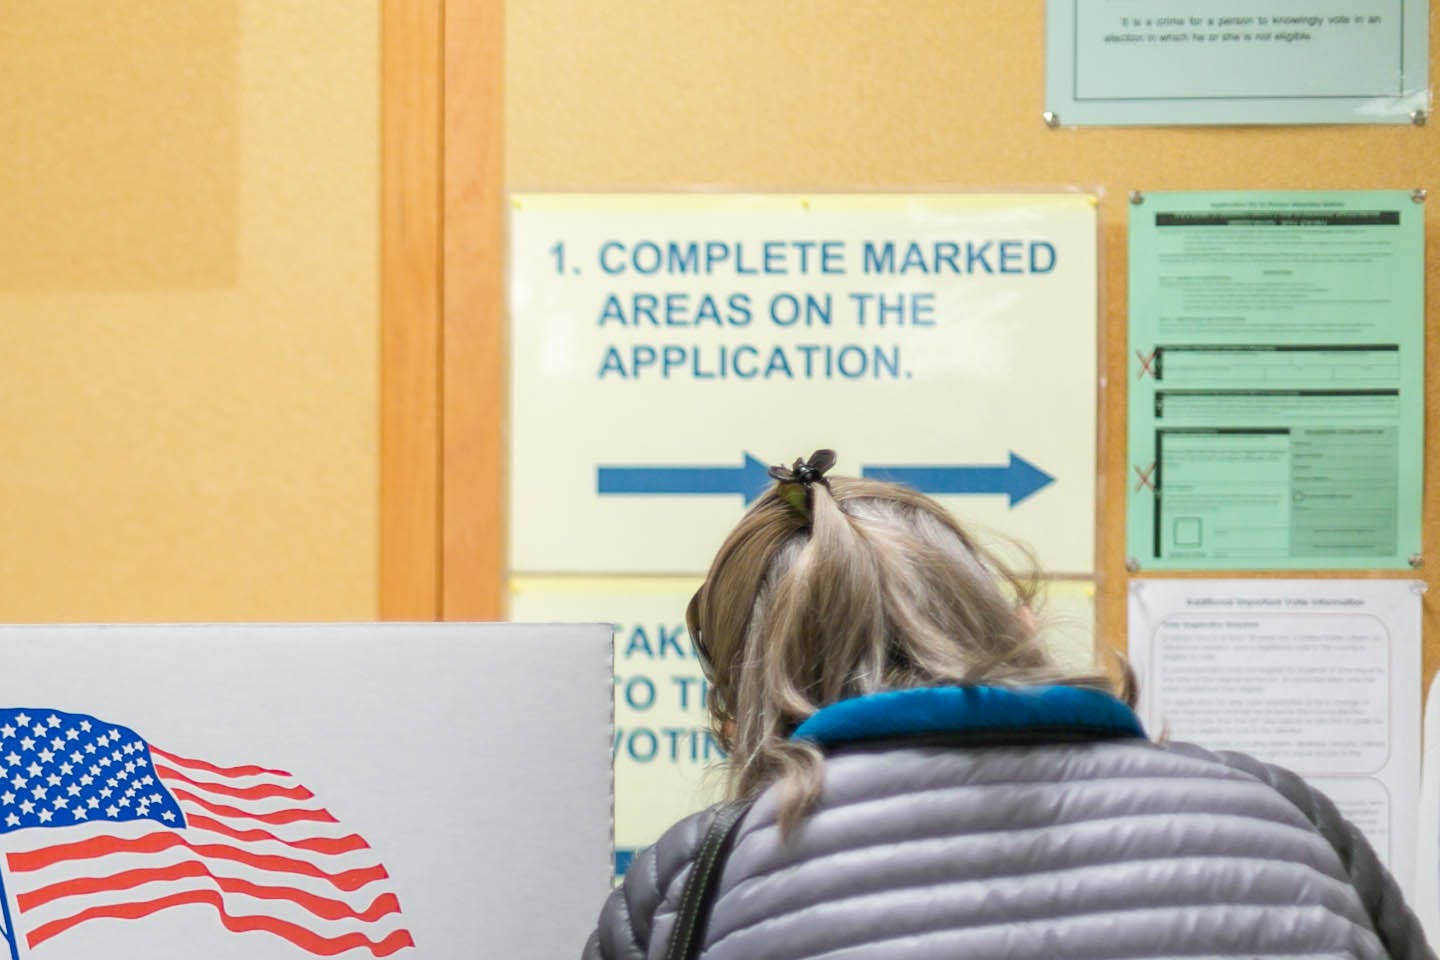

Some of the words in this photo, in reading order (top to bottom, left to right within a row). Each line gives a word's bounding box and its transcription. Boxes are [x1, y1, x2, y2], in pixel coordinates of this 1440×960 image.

[1104, 33, 1145, 43] election
[1159, 32, 1188, 42] which
[1192, 32, 1205, 42] he
[1221, 32, 1241, 42] she
[1255, 32, 1272, 41] not
[1156, 17, 1186, 27] crime
[1189, 16, 1203, 27] for
[1218, 17, 1254, 28] person
[1257, 16, 1269, 26] to
[1271, 15, 1325, 28] knowingly
[1327, 16, 1351, 26] vote
[1367, 16, 1382, 25] an
[548, 240, 582, 277] 1.
[597, 239, 848, 277] COMPLETE
[862, 239, 1058, 277] MARKED
[596, 291, 754, 329] AREAS
[768, 291, 834, 329] ON
[847, 291, 937, 329] THE
[596, 343, 914, 381] APPLICATION.
[613, 624, 698, 658] AK
